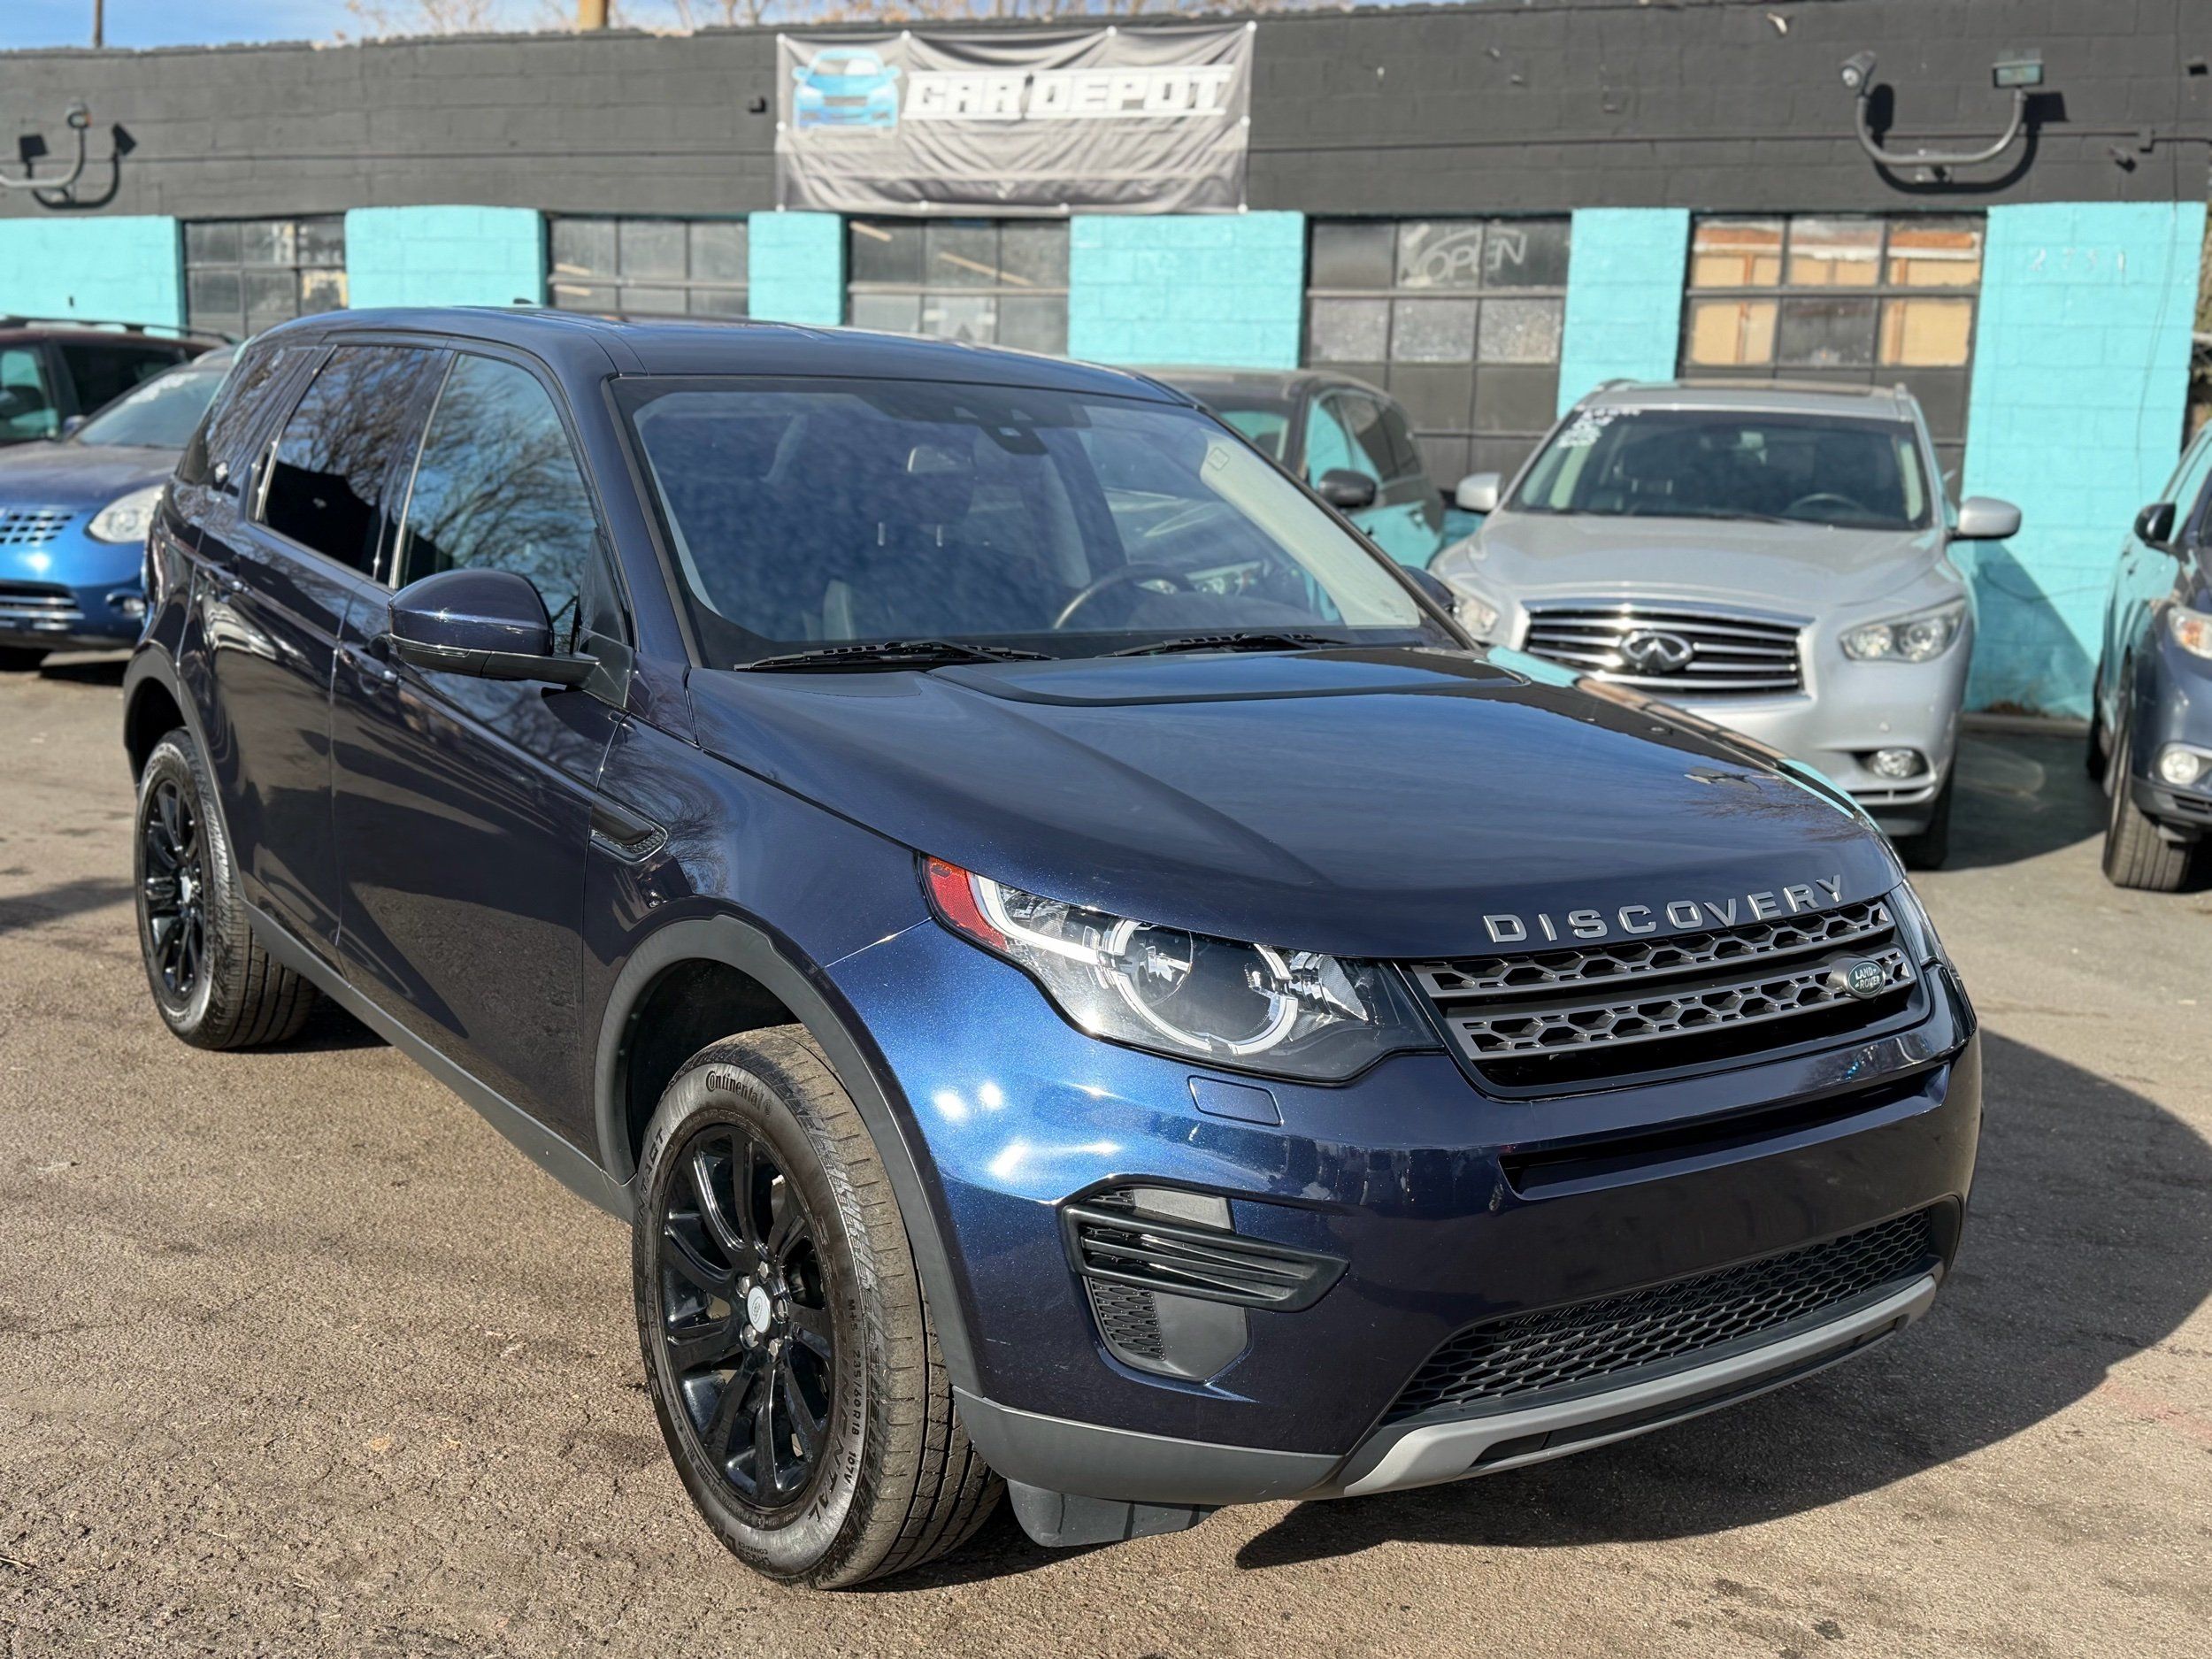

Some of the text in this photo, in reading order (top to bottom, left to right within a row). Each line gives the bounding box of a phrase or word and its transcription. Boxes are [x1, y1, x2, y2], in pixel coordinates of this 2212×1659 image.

[902, 65, 1234, 119] CAR DEPOT
[1425, 234, 1528, 281] OPEN
[1483, 874, 1843, 943] DISCOVERY
[1855, 966, 1873, 980] LAND
[1859, 975, 1880, 989] ROVER
[705, 1071, 764, 1111] Continental
[843, 1450, 856, 1485] 107V
